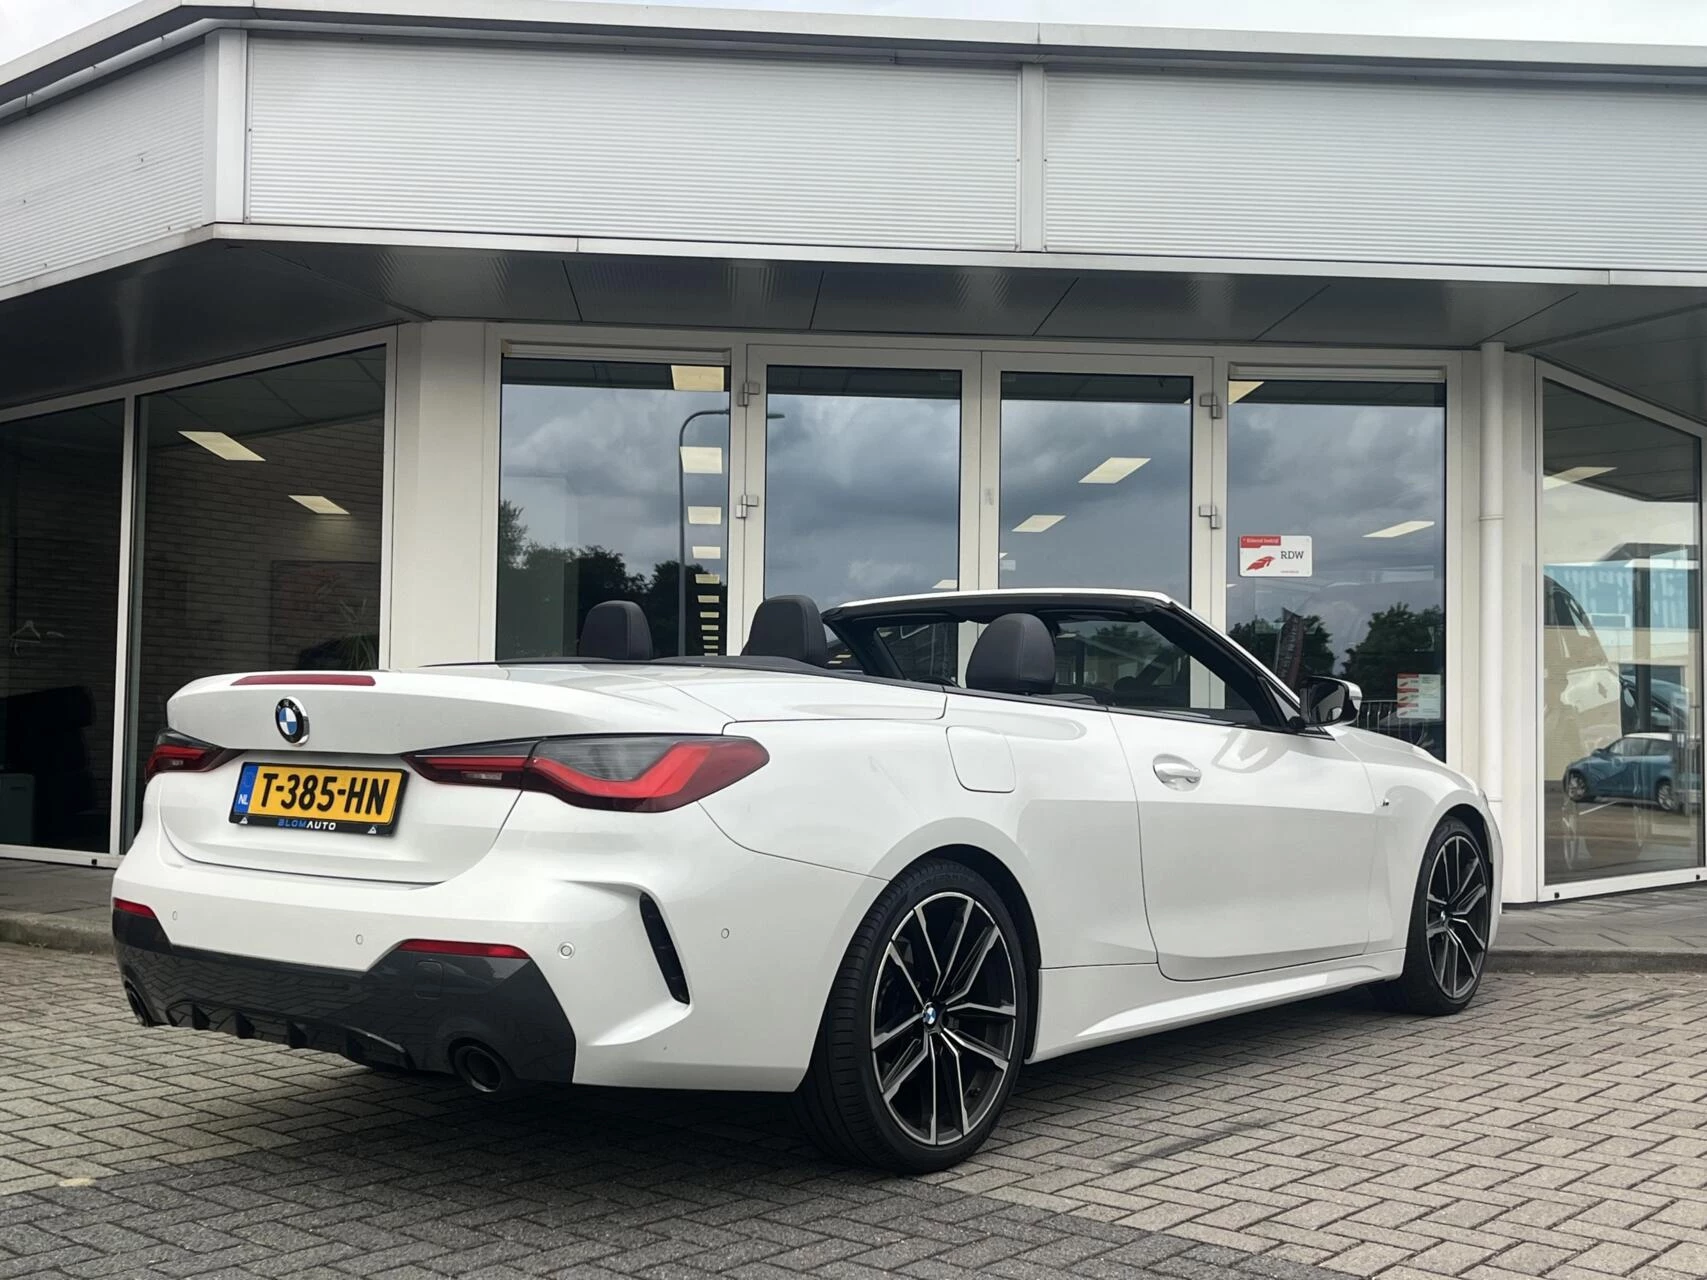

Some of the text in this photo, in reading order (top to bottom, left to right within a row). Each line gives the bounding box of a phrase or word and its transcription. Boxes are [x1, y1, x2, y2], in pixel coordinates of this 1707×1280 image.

[1280, 550, 1305, 560] RDW
[238, 794, 249, 805] NL
[261, 773, 390, 815] T-385-HN
